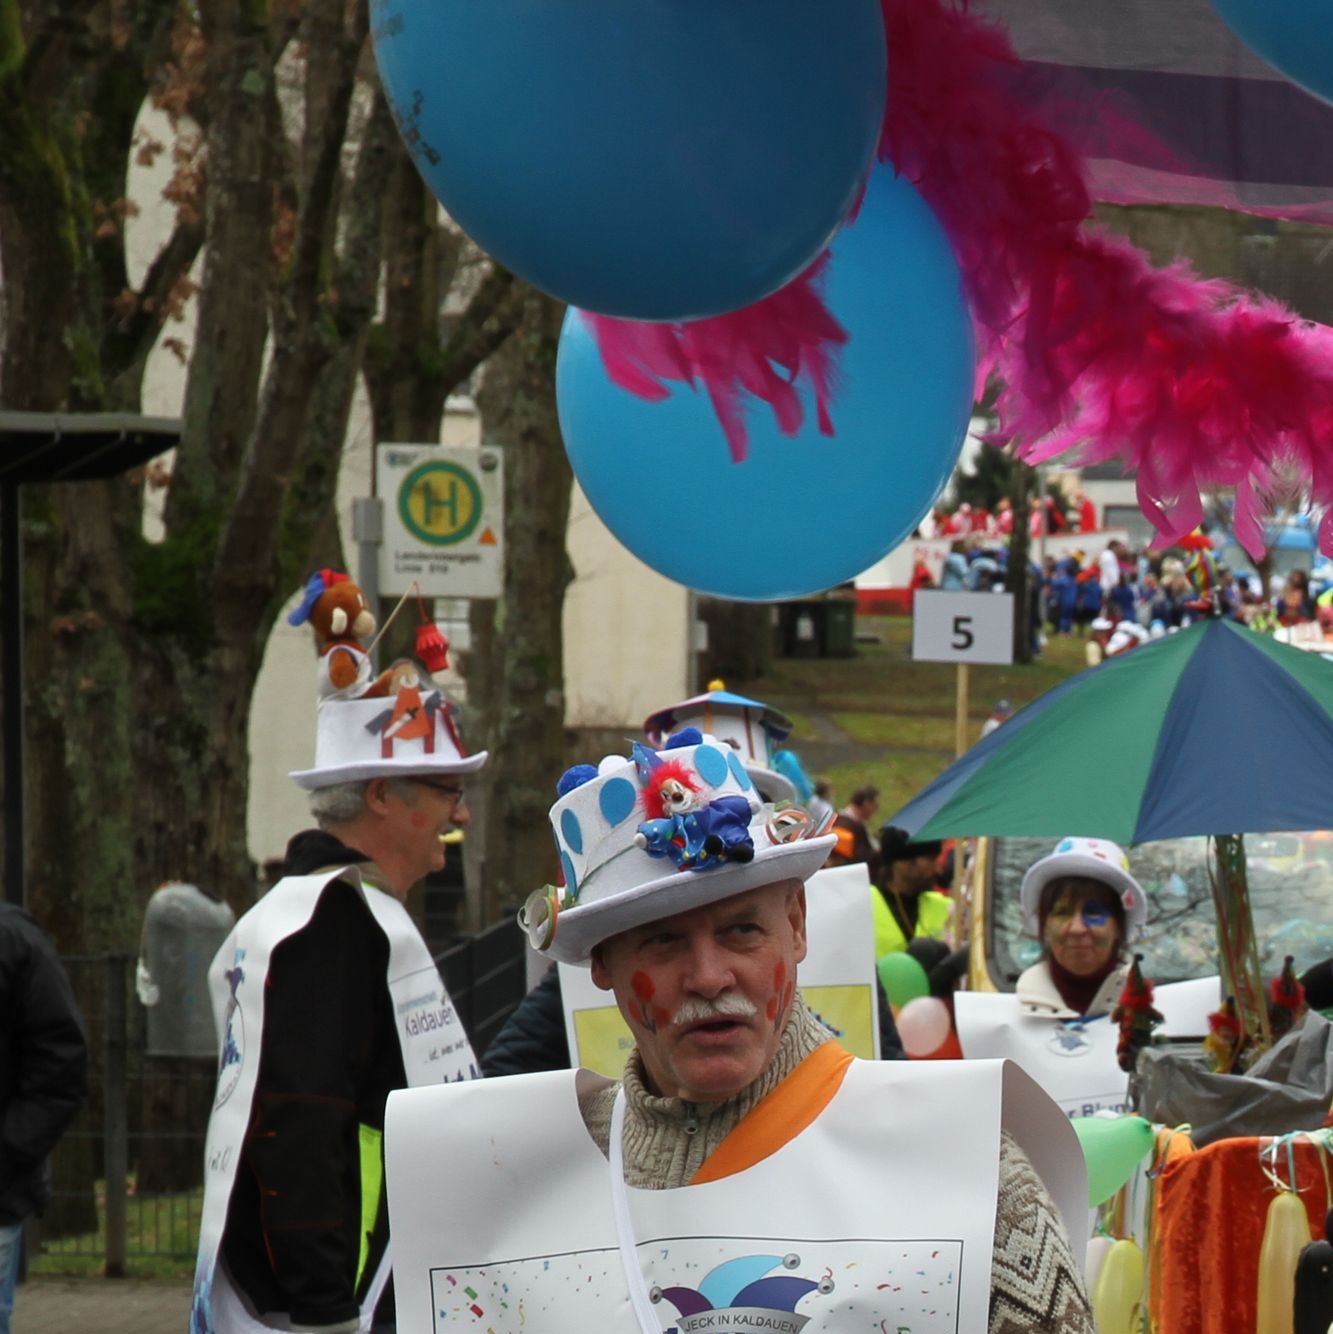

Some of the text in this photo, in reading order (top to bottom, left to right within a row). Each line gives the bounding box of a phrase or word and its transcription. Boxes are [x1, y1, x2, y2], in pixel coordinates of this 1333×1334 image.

[423, 480, 458, 528] H
[951, 616, 974, 650] 5
[685, 1314, 799, 1334] JECK IN KALDAUEN
